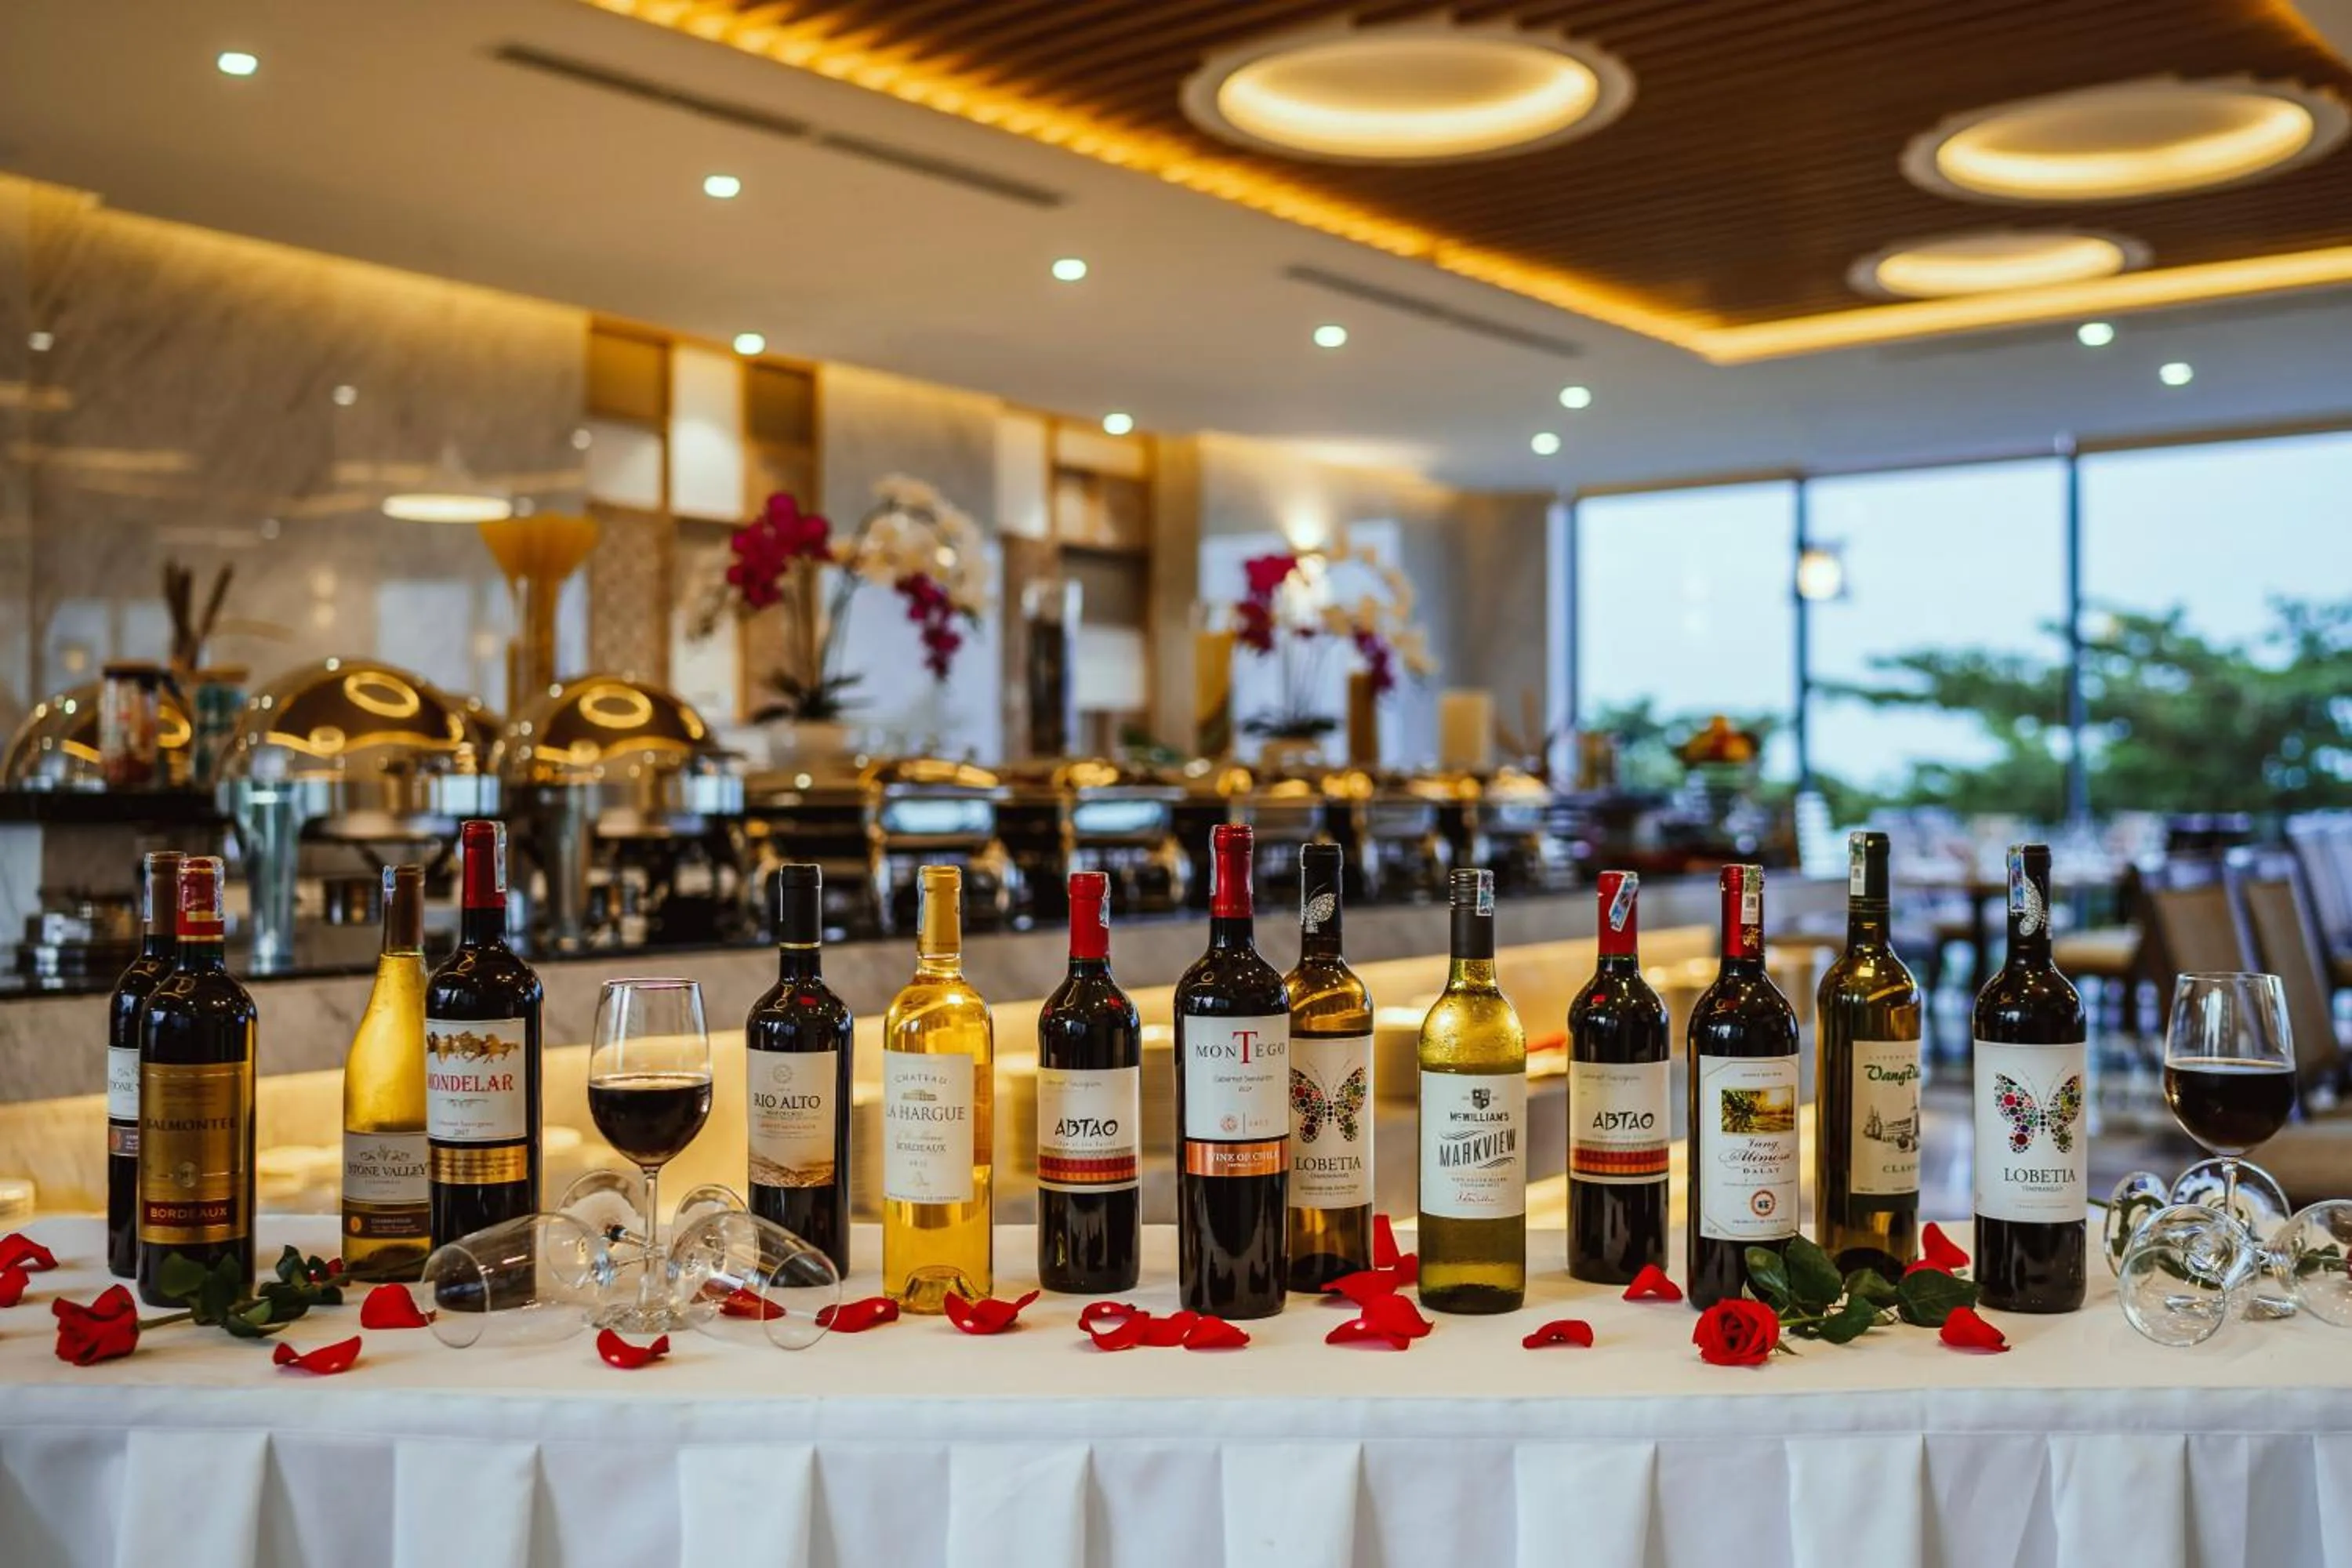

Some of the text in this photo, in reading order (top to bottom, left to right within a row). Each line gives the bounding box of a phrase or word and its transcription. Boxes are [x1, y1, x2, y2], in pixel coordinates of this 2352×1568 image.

[1195, 1030, 1286, 1064] MONTEGO
[753, 1093, 822, 1109] RIO ALTO
[899, 1105, 965, 1122] HARGUE
[1592, 1111, 1655, 1131] ABTAO
[1054, 1117, 1119, 1138] ABTAO
[1439, 1128, 1516, 1167] MARKVIEW
[348, 1163, 380, 1177] STONE
[383, 1162, 427, 1177] VALLEY
[1295, 1156, 1362, 1171] LOBETIA
[2004, 1167, 2076, 1183] LOBETIA
[150, 1207, 229, 1219] BORDAUX
